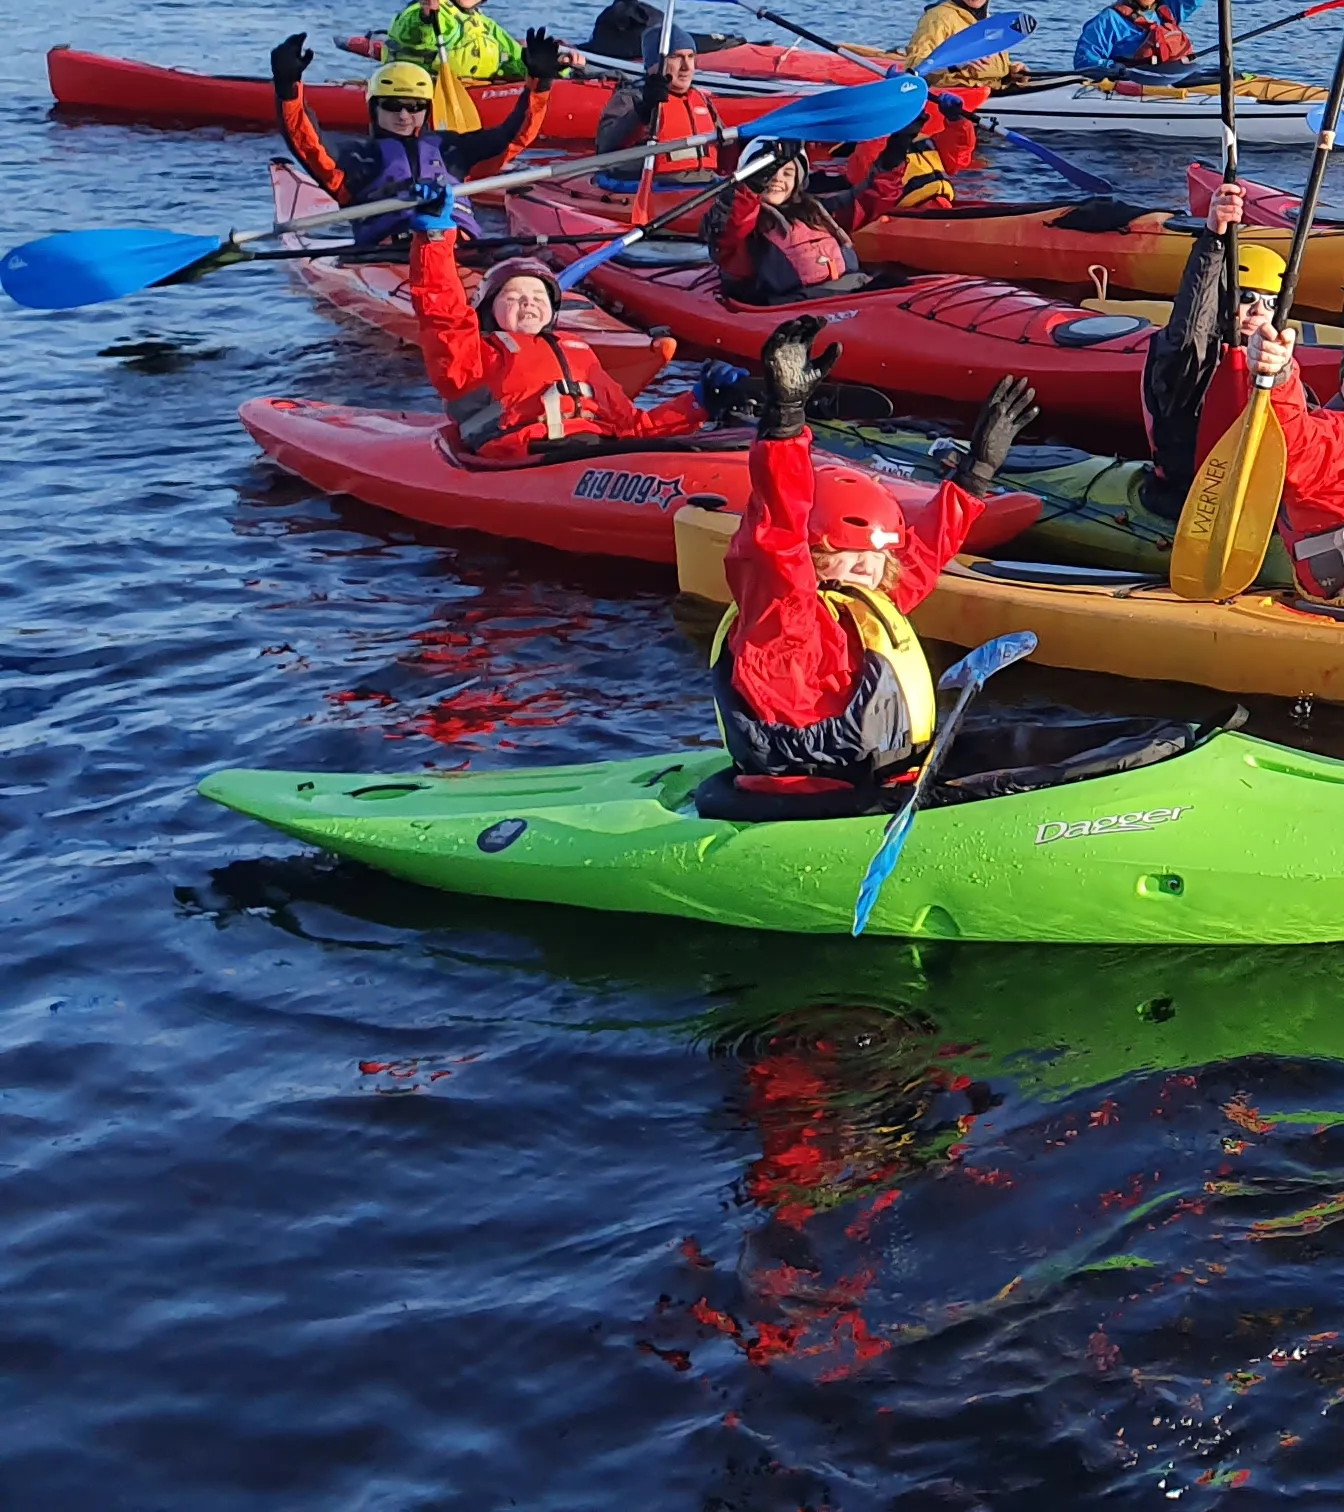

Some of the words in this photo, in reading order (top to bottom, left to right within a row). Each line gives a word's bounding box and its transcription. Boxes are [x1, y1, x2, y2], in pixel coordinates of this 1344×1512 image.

[574, 470, 614, 500] Big
[1191, 458, 1228, 534] WERNER
[1034, 805, 1194, 845] Dagger
